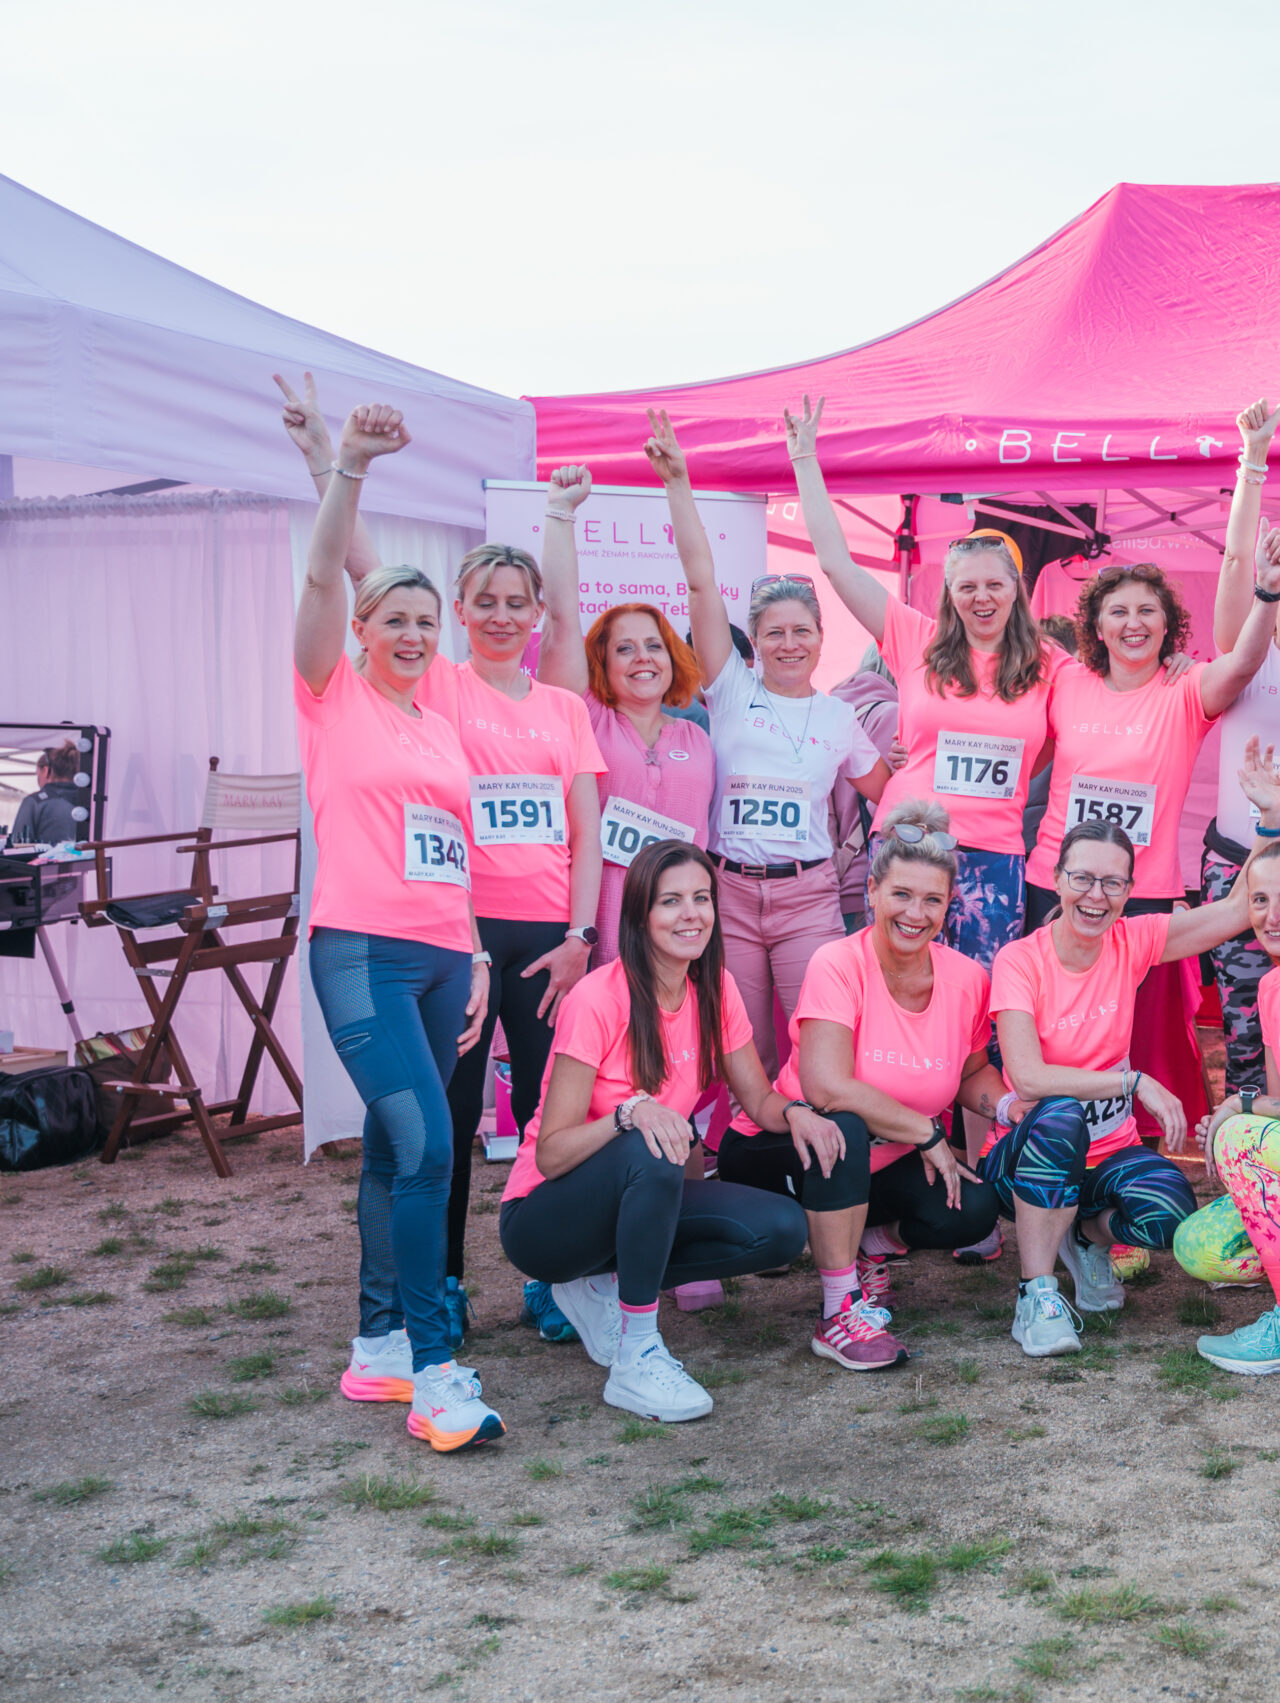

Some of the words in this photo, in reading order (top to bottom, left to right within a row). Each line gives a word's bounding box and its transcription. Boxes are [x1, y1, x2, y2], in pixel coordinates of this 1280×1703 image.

[638, 552, 681, 560] RAKOVINO
[596, 581, 613, 594] to
[618, 583, 671, 597] sama,
[579, 600, 612, 614] tad
[659, 602, 690, 616] Teb
[944, 739, 966, 747] MARY
[968, 741, 983, 749] KAY
[984, 743, 1000, 751] RUN
[1000, 744, 1017, 752] 2025
[947, 755, 1009, 786] 1176
[478, 783, 503, 791] MARY
[522, 782, 539, 790] RUN
[730, 782, 750, 790] MARY
[752, 783, 767, 791] KAY
[768, 784, 785, 792] RUN
[785, 785, 803, 794] 2025
[1078, 782, 1098, 791] MARY
[1099, 784, 1113, 794] KAY
[1114, 787, 1130, 796] RUN
[1130, 789, 1147, 798] 2025
[412, 813, 433, 823] MARY
[481, 800, 552, 828] 1591
[729, 798, 800, 828] 1250
[1075, 798, 1144, 830] 1587
[613, 804, 636, 817] MARY
[637, 813, 652, 824] KAY
[652, 819, 669, 831] RUN
[669, 827, 686, 839] 2025
[414, 833, 466, 874] 1342
[873, 1049, 943, 1071] BELLIS
